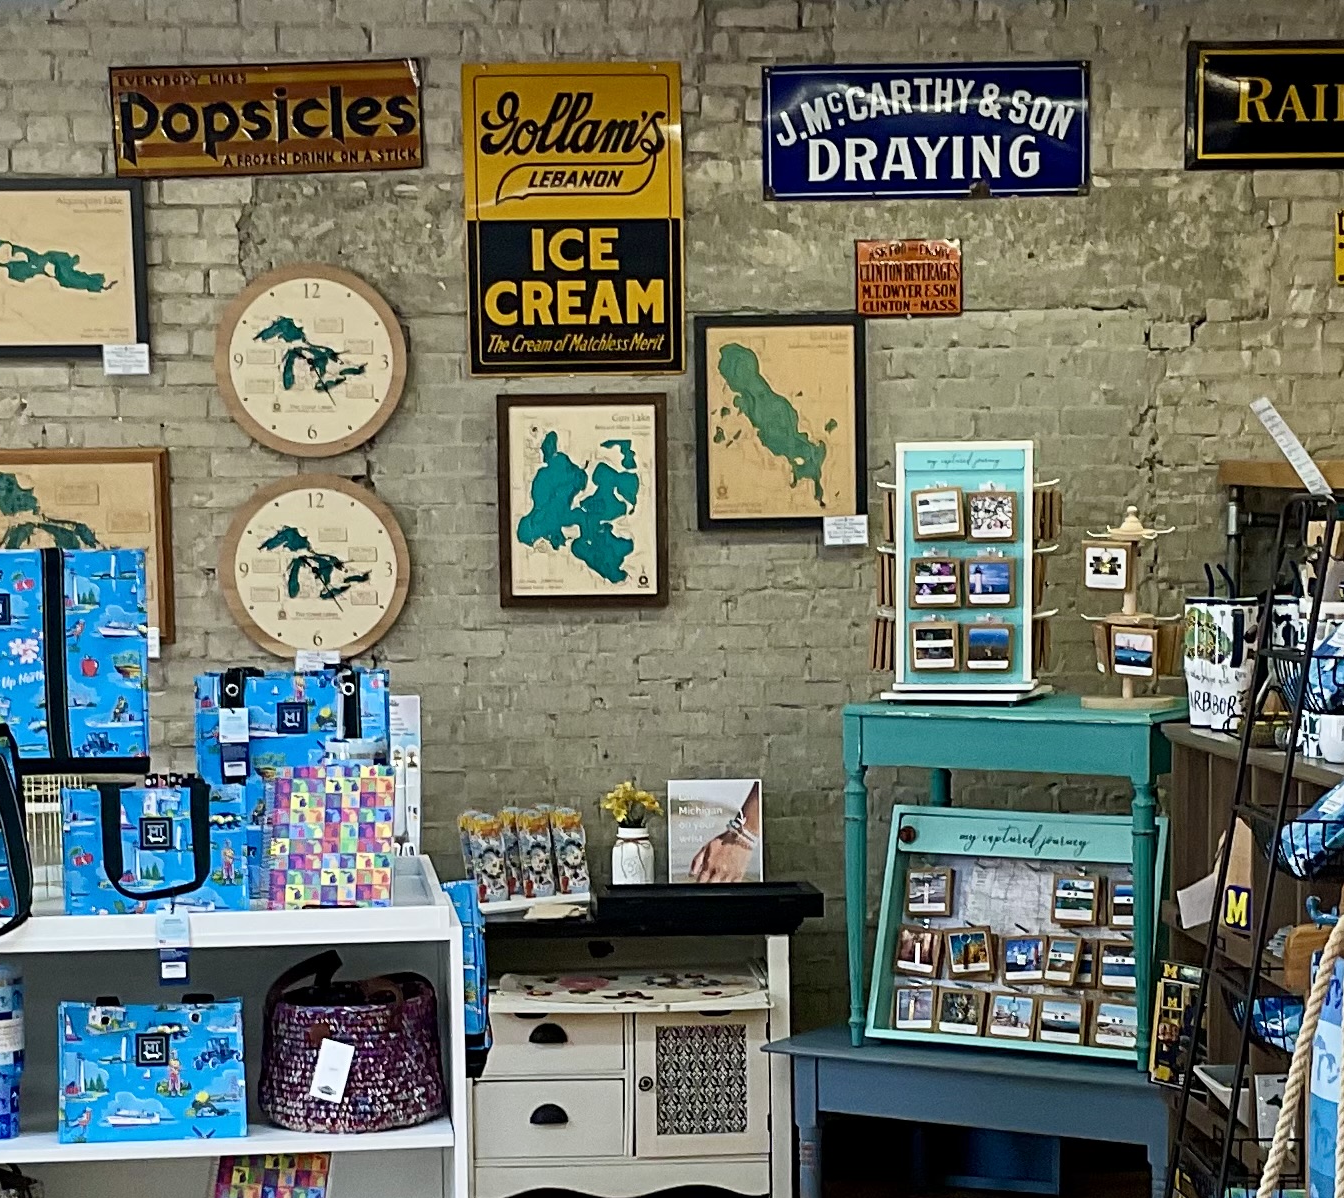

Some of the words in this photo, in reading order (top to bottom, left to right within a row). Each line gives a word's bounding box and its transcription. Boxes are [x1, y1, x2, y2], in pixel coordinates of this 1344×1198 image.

[117, 74, 200, 87] EVERYBODY
[210, 73, 248, 84] LIKES
[978, 82, 1002, 120] &
[1008, 88, 1076, 141] SON
[119, 85, 419, 167] Popsicles
[480, 91, 667, 156] Gollam's
[224, 155, 233, 167] A
[237, 152, 289, 167] FROZEN
[293, 150, 335, 164] DRINK
[341, 149, 358, 163] ON
[363, 150, 373, 163] A
[378, 148, 418, 161] STICK
[808, 134, 1041, 183] DRAYING
[528, 170, 624, 189] LEBANON
[531, 227, 621, 272] ICE
[904, 262, 960, 281] BEVERAGES
[303, 282, 322, 299] 12
[933, 284, 957, 297] SON
[484, 279, 666, 326] CREAM
[863, 300, 911, 312] CLINTON
[487, 333, 511, 353] The
[512, 333, 551, 353] Cream
[553, 332, 570, 353] of
[571, 332, 630, 353] Matchless
[631, 331, 666, 352] Merit
[233, 352, 244, 369] 9
[381, 353, 390, 370] 3
[631, 413, 651, 423] Lake
[307, 424, 318, 440] 6
[307, 491, 325, 509] 12
[239, 561, 250, 579] 9
[385, 560, 394, 578] 3
[312, 630, 324, 648] 6
[1, 674, 13, 690] Up
[678, 806, 723, 817] Michigan
[678, 833, 703, 844] wrist
[958, 833, 978, 851] my
[981, 824, 1044, 852] captured
[1226, 889, 1249, 928] M
[1163, 964, 1179, 979] M
